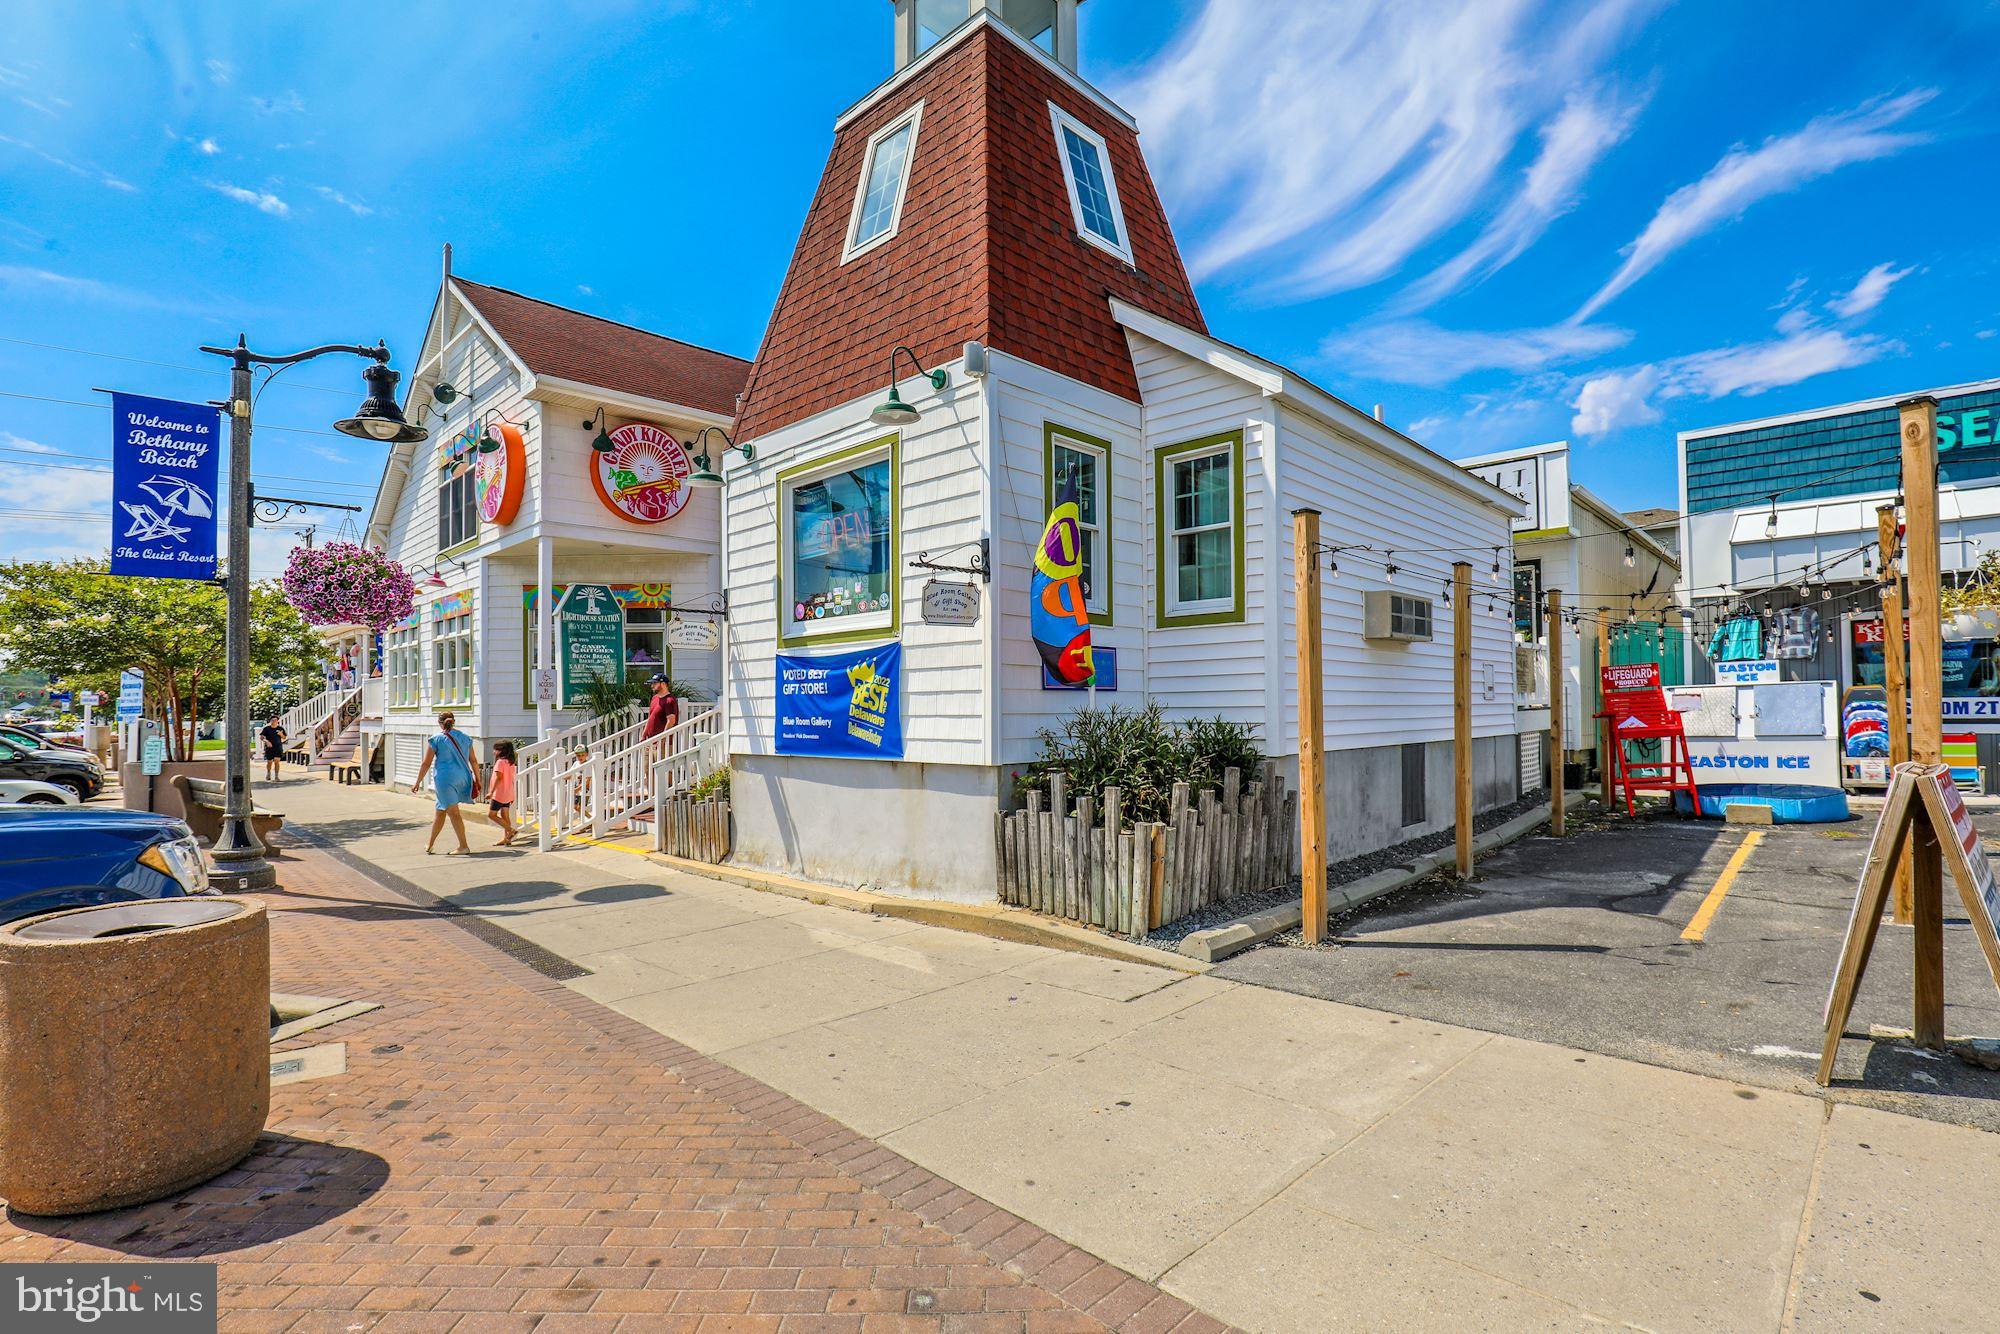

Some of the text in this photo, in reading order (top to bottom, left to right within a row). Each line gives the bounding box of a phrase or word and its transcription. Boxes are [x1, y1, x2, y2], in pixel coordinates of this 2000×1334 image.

[127, 412, 209, 434] Welcome to
[1936, 409, 2000, 452] SE
[127, 429, 209, 457] Bethany
[138, 448, 199, 469] Beach
[602, 426, 688, 479] CANDY KITCHEN
[819, 511, 870, 549] OPEN
[115, 547, 214, 563] The Quiet Resort
[926, 592, 938, 601] Blue
[958, 589, 977, 605] Gallery
[942, 599, 952, 607] Gift
[954, 599, 968, 608] Shop
[562, 610, 620, 622] LIGHTHOUSE STATION
[700, 625, 717, 637] Gallery
[783, 668, 830, 681] VOTED BEST
[1608, 668, 1652, 680] LIFEGUARD
[1718, 662, 1776, 673] EASTON
[874, 674, 890, 687] 2022
[1737, 673, 1758, 682] ICE
[783, 682, 828, 695] GIFT STORE!
[851, 683, 889, 714] BEST
[783, 716, 832, 729] Blue Room Gallery
[849, 704, 886, 728] Delaware
[1690, 755, 1810, 769] EASTON ICE
